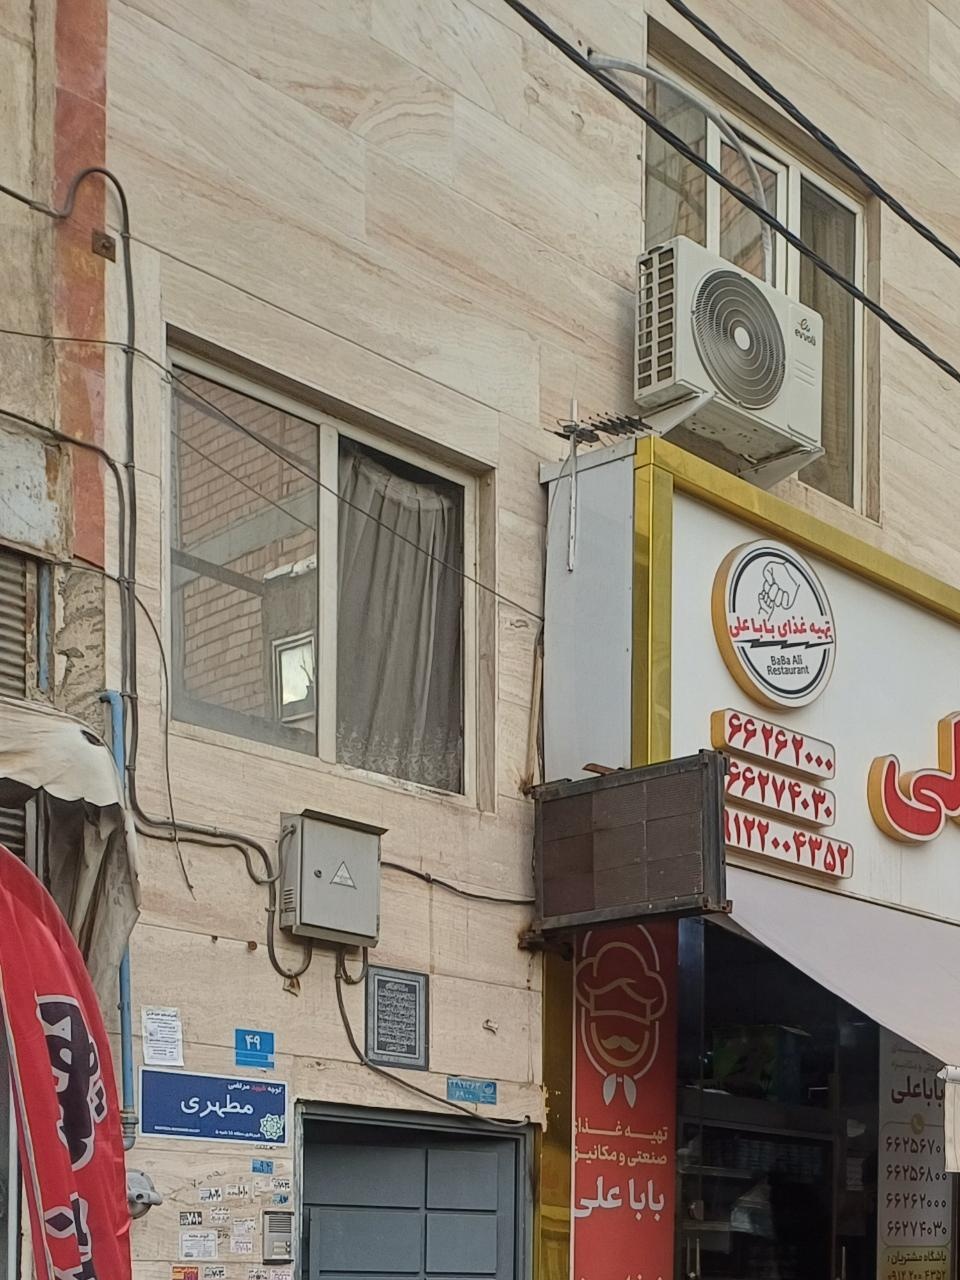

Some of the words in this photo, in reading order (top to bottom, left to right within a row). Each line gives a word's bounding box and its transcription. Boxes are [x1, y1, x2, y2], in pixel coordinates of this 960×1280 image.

[729, 616, 750, 638] علی
[751, 618, 775, 639] بابا
[778, 616, 807, 637] غذای
[767, 665, 810, 675] Restaurant
[770, 656, 791, 666] BaBa
[792, 655, 803, 665] Ali
[728, 712, 833, 771] ۶۶۲۶۲۰۰۰
[726, 761, 833, 820] ۶۶۲۷۴۰۳۰
[245, 1034, 261, 1050] ۴۹
[891, 1076, 922, 1104] علی
[923, 1077, 944, 1107] بابا
[180, 1094, 254, 1118] مطهری
[624, 1124, 668, 1145] تهیه
[574, 1143, 617, 1166] مکانیز
[885, 1136, 945, 1155] ۶۶۲۵۶۷۰
[618, 1151, 625, 1165] و
[627, 1150, 668, 1167] صنعتی
[886, 1164, 947, 1182] ۶۶۲۵۶۸۰۰
[574, 1176, 623, 1218] علی
[628, 1178, 665, 1222] بابا
[886, 1192, 947, 1208] ۶۶۲۶۲۰۰۰
[887, 1221, 947, 1237] ۶۶۲۷۴۰۳۰
